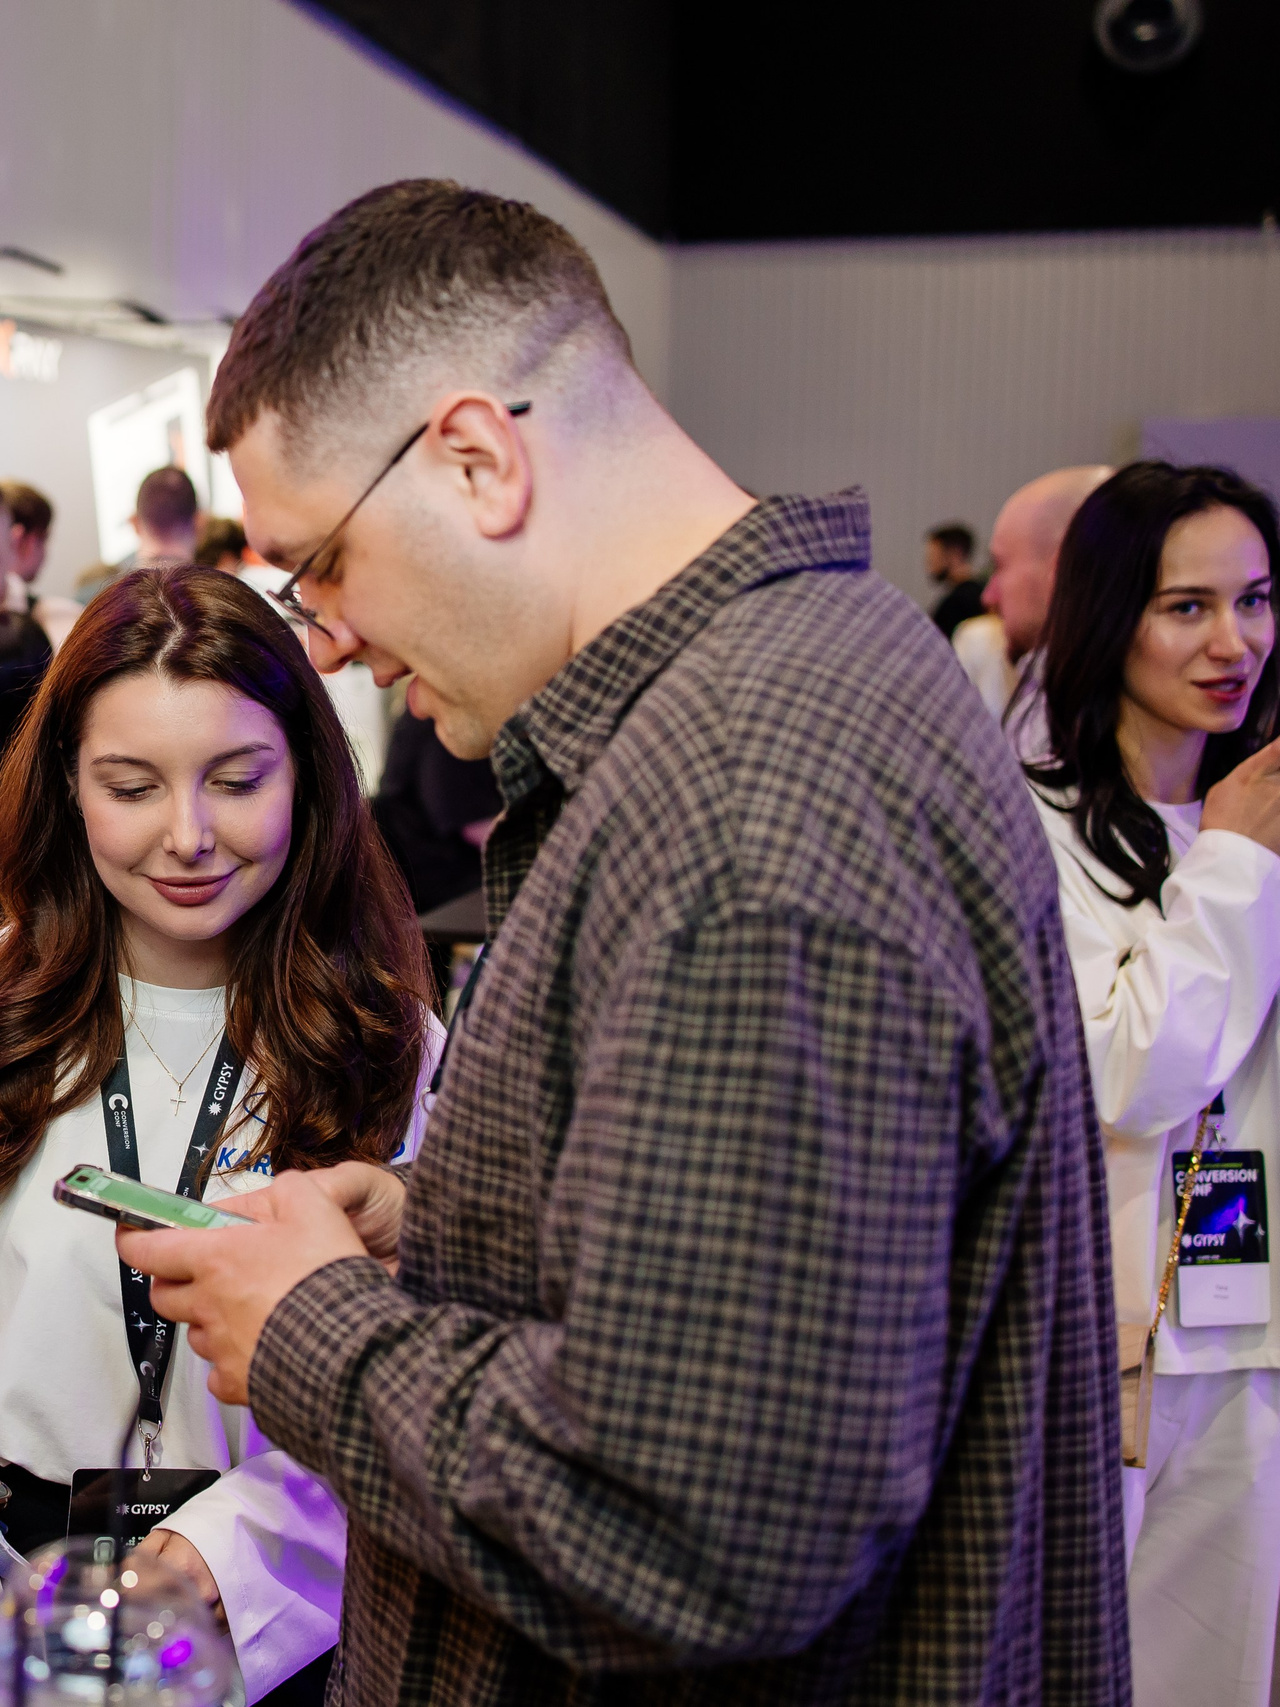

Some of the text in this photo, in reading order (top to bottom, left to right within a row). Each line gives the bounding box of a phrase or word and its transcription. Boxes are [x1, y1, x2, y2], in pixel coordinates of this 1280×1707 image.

[213, 1062, 234, 1101] GYPSY
[113, 1110, 121, 1128] CONF
[120, 1110, 131, 1150] CONVERSION
[1175, 1168, 1258, 1184] CNVERSION
[1192, 1232, 1227, 1248] GYPSY
[130, 1503, 171, 1515] GYPSY
